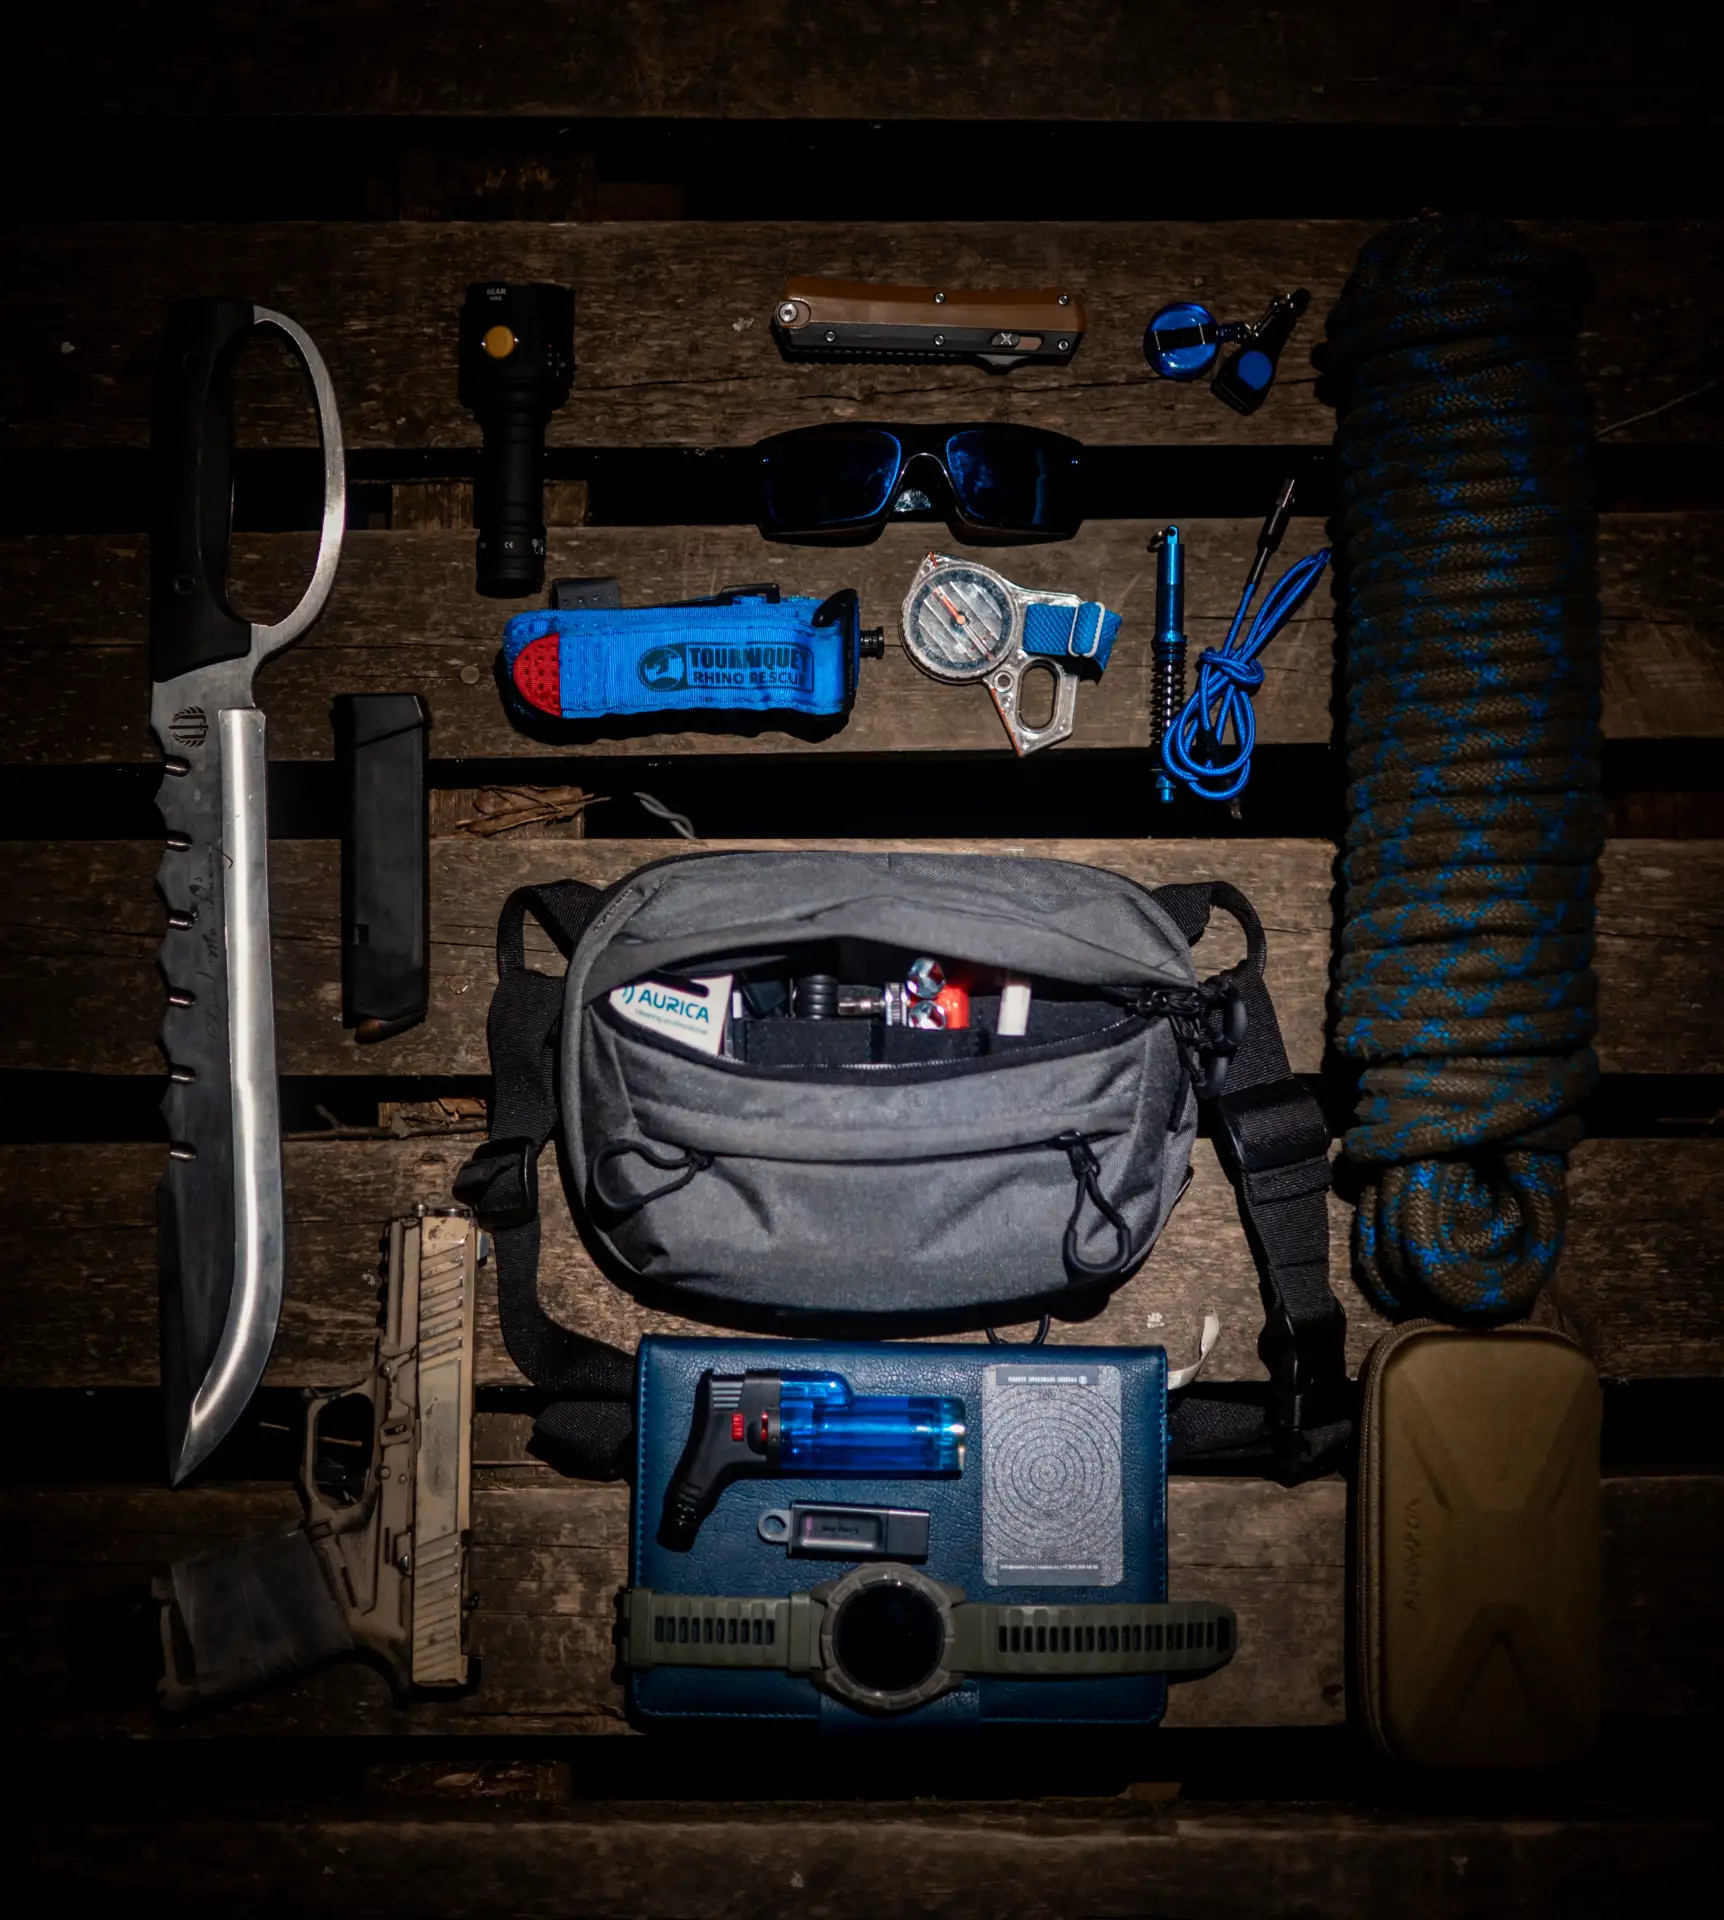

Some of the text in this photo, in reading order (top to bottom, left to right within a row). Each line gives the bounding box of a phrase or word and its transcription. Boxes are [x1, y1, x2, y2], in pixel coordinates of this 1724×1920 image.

[688, 647, 809, 672] TOURNIQUET
[693, 671, 807, 687] RHINO RESCUE
[638, 989, 709, 1024] AURICA
